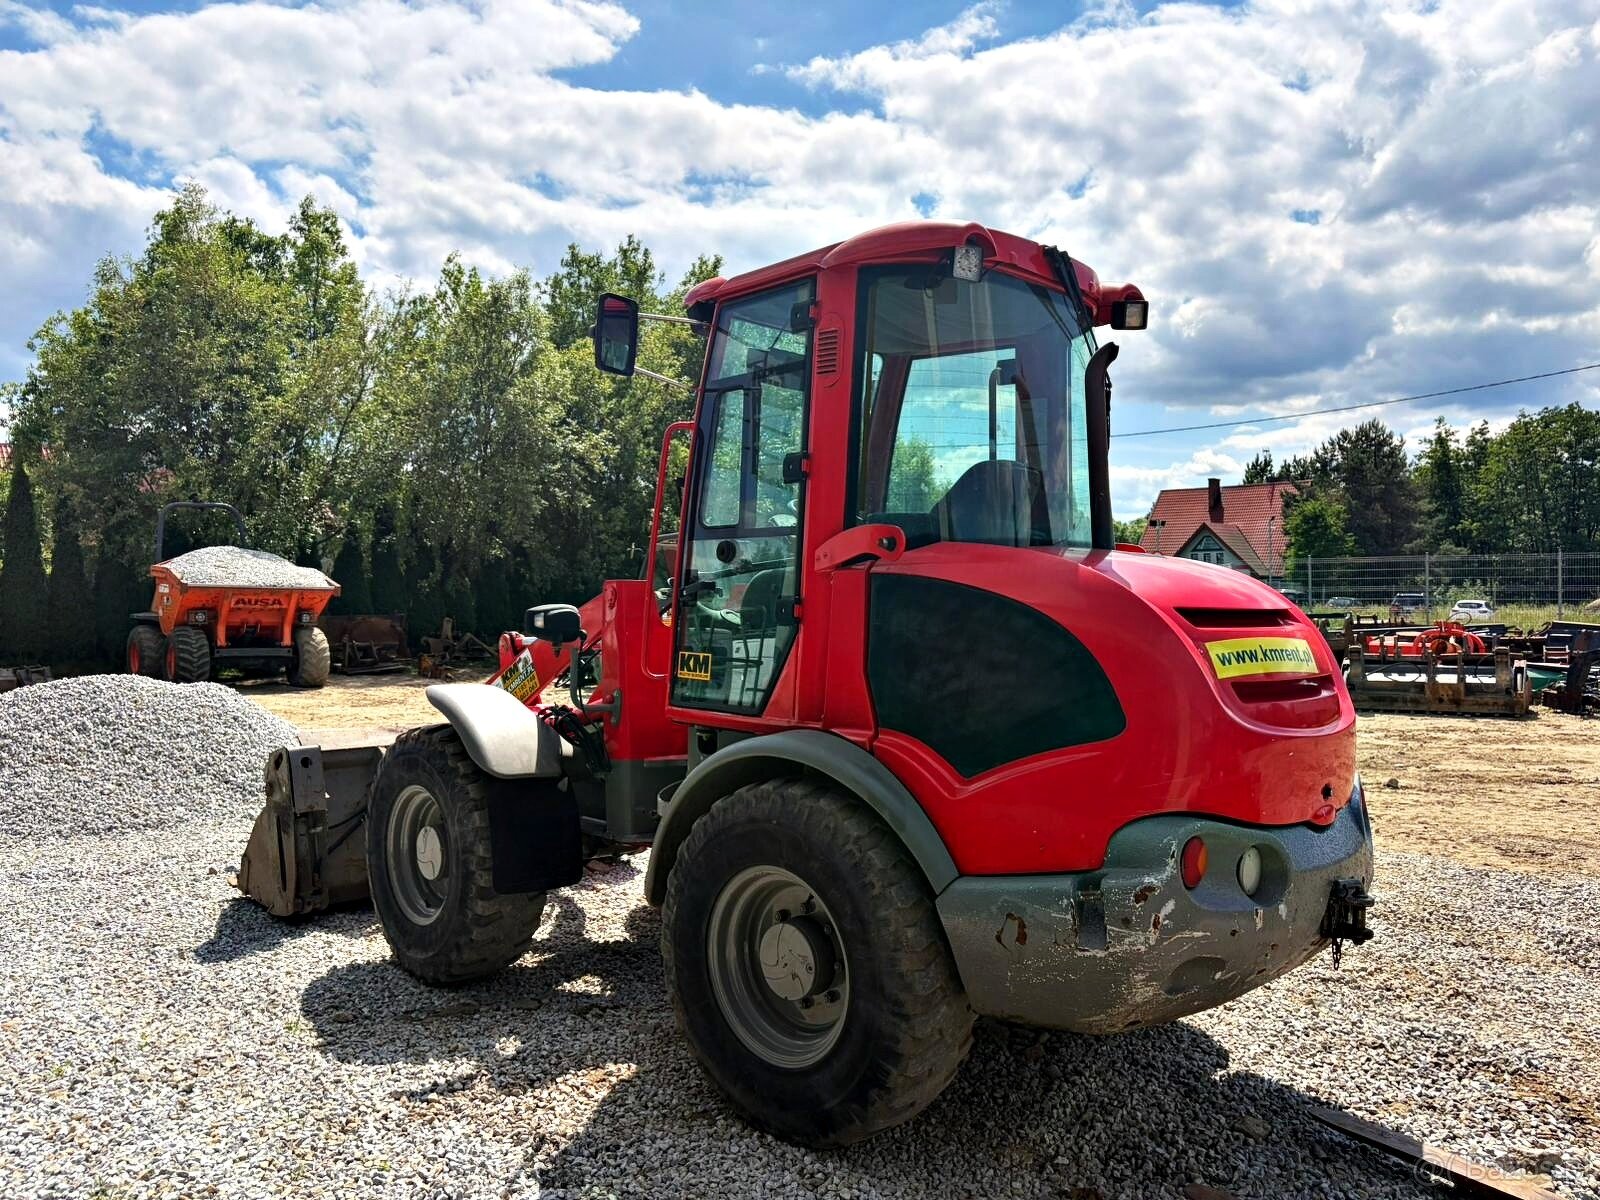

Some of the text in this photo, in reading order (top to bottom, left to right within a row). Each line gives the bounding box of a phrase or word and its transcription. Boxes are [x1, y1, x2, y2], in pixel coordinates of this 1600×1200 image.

[233, 598, 284, 606] AUSA
[679, 653, 710, 674] KM
[1216, 644, 1313, 666] www.kmrent.pl
